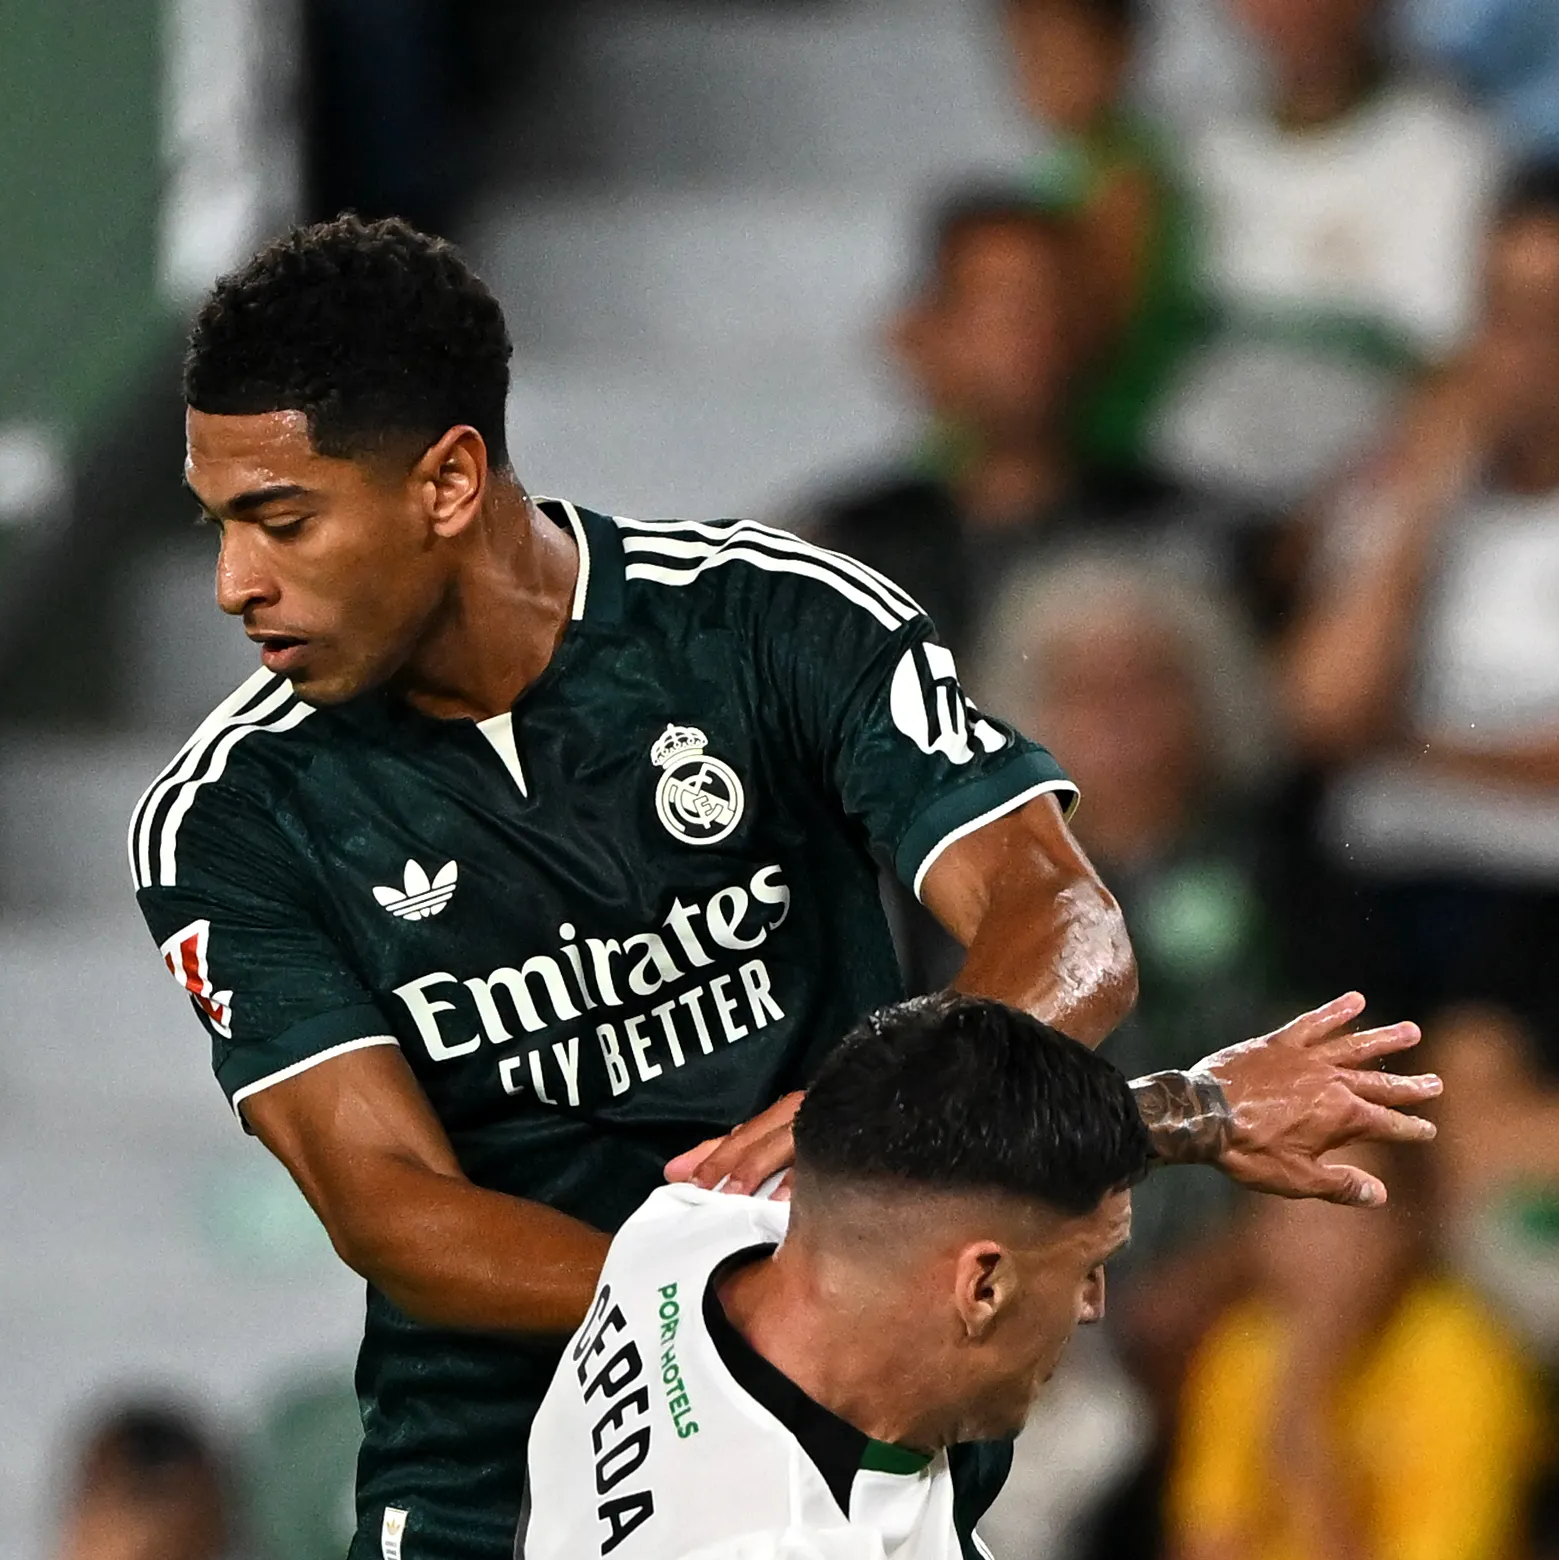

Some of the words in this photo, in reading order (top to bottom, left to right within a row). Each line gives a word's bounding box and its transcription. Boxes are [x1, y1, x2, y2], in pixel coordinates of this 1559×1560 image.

[392, 863, 791, 1062] Emirates
[498, 1037, 579, 1107] FLY
[596, 958, 786, 1097] BETTER
[660, 1345, 700, 1439] HOTELS
